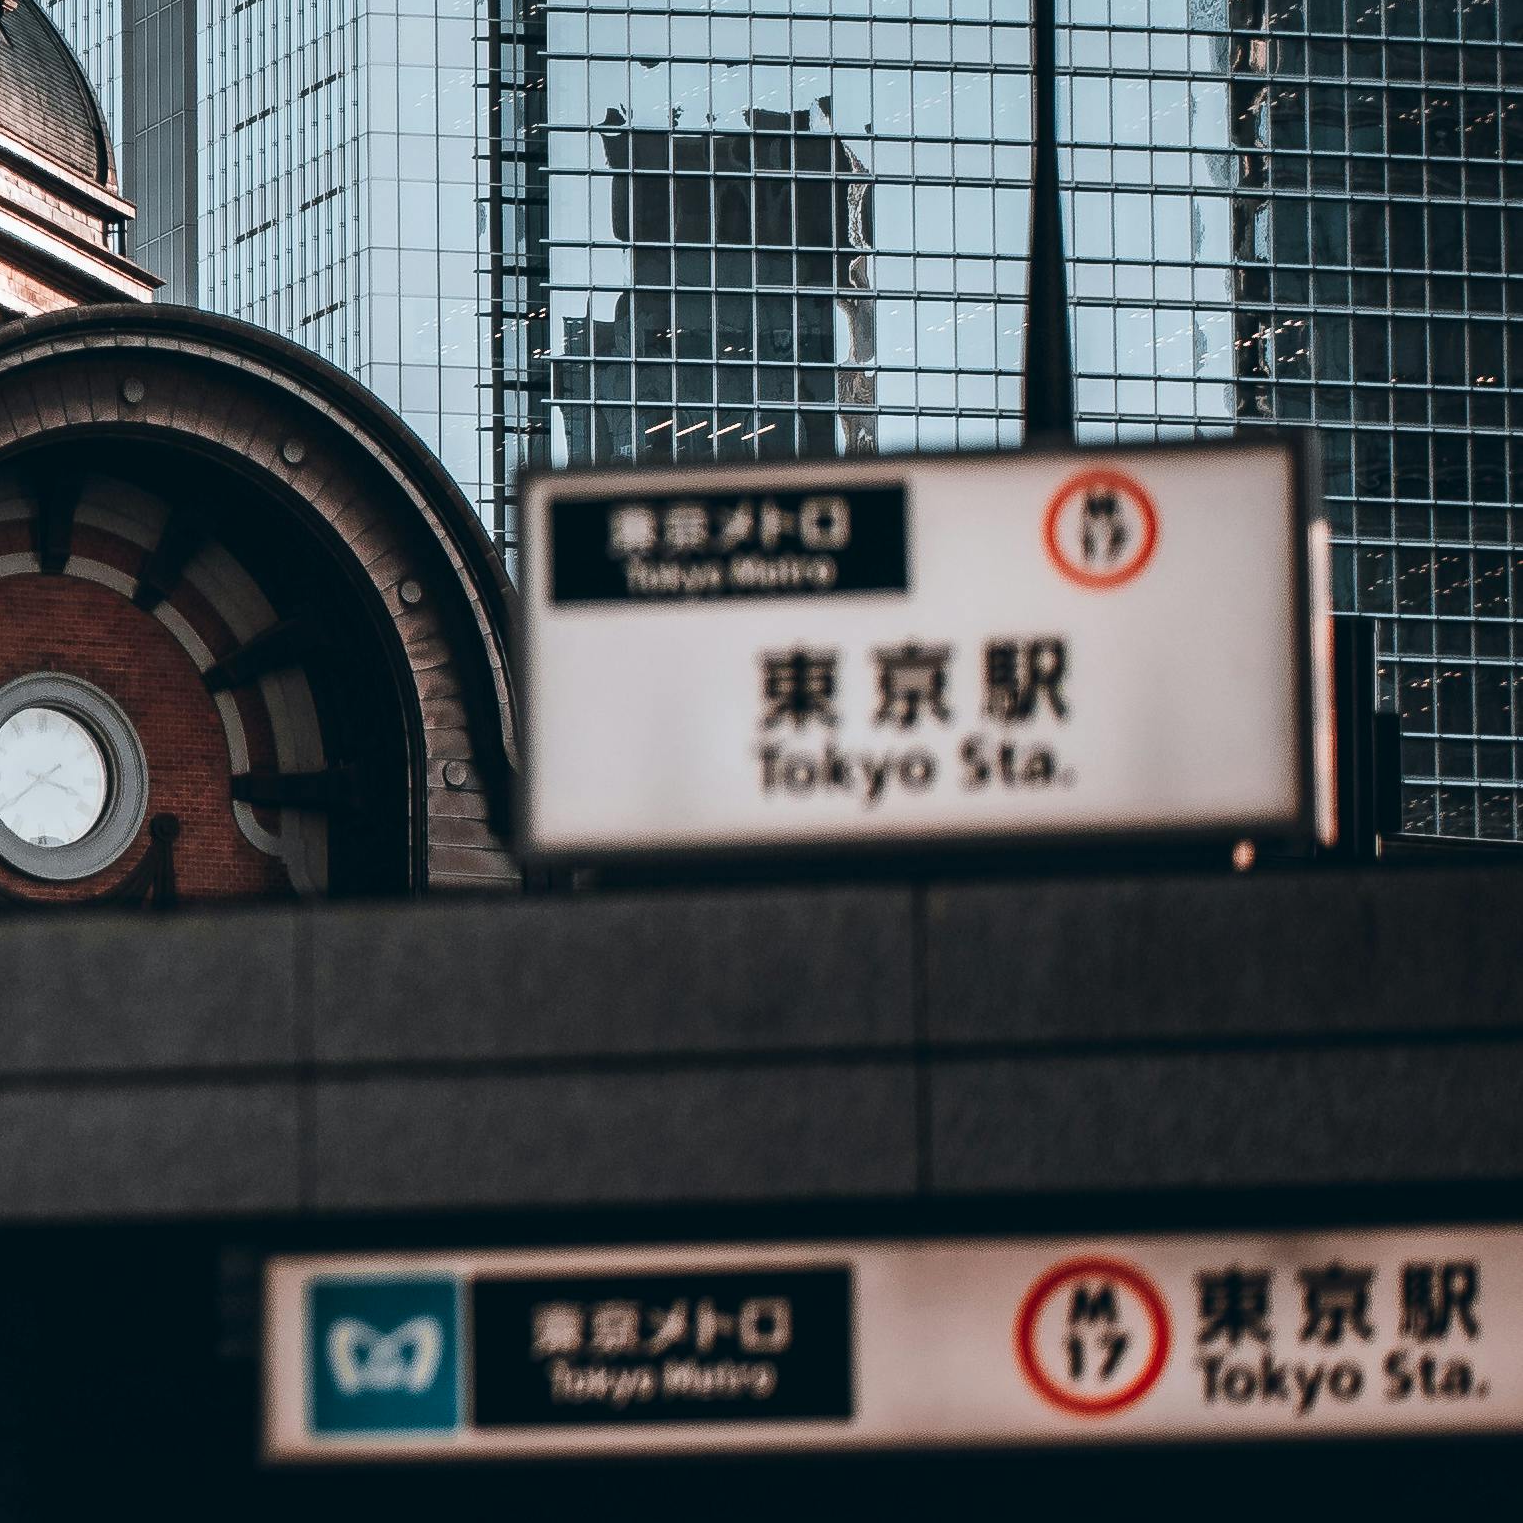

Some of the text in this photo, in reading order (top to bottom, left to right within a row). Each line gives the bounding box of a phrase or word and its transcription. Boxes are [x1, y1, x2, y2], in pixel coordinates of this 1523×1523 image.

[757, 635, 1073, 729] 東京駅
[757, 734, 1077, 807] Tokyo Sta.
[1068, 1283, 1118, 1324] M
[1194, 1261, 1480, 1345] 東京駅
[1065, 1332, 1130, 1380] 17
[1193, 1351, 1490, 1417] Tokyo Sta.
